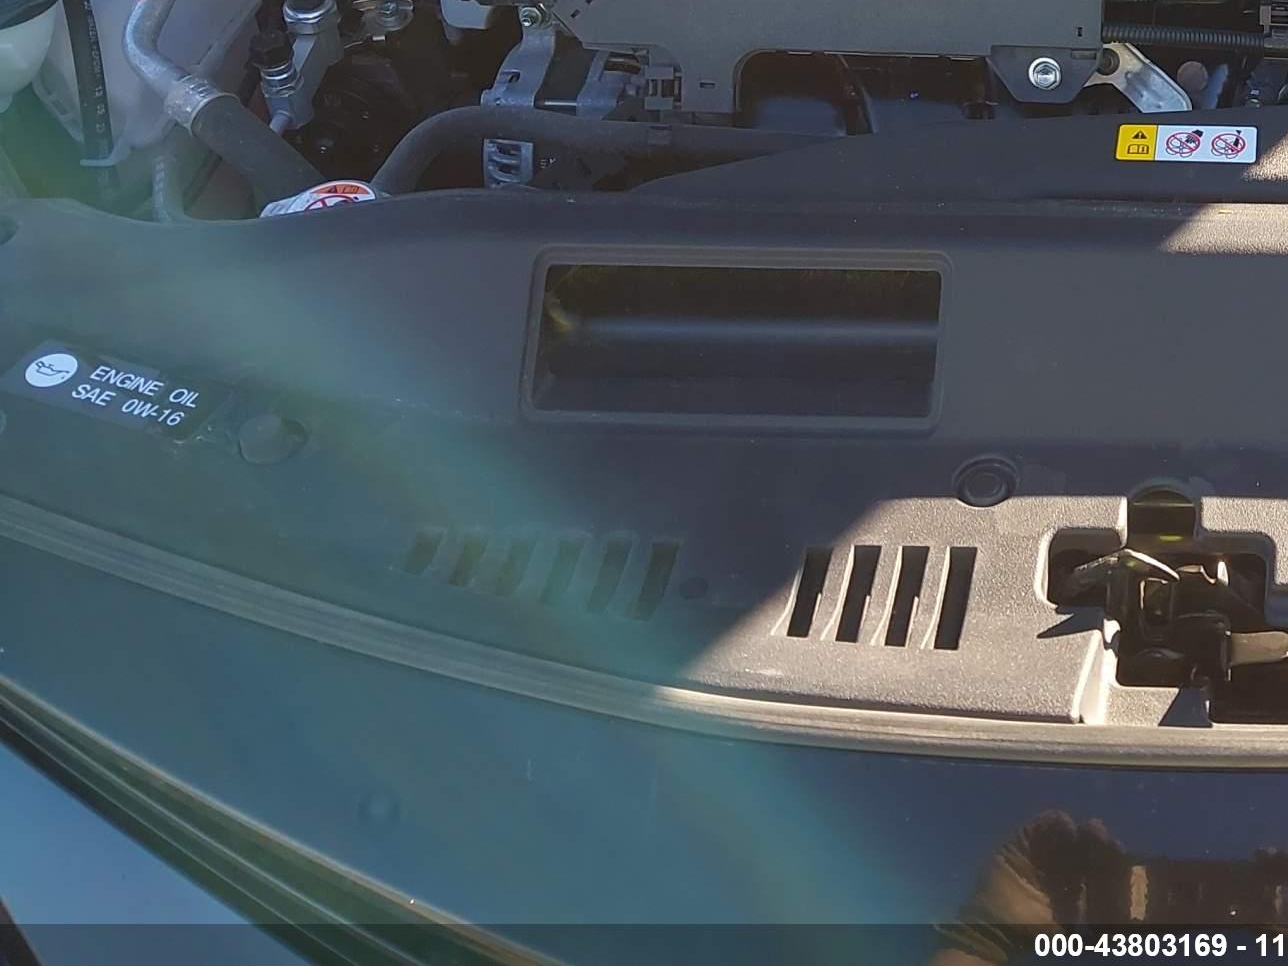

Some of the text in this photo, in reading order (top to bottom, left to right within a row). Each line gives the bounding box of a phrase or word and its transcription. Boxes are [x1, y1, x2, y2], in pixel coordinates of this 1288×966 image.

[71, 384, 185, 426] SAE 0W-16
[89, 365, 200, 408] ENGINE OIL
